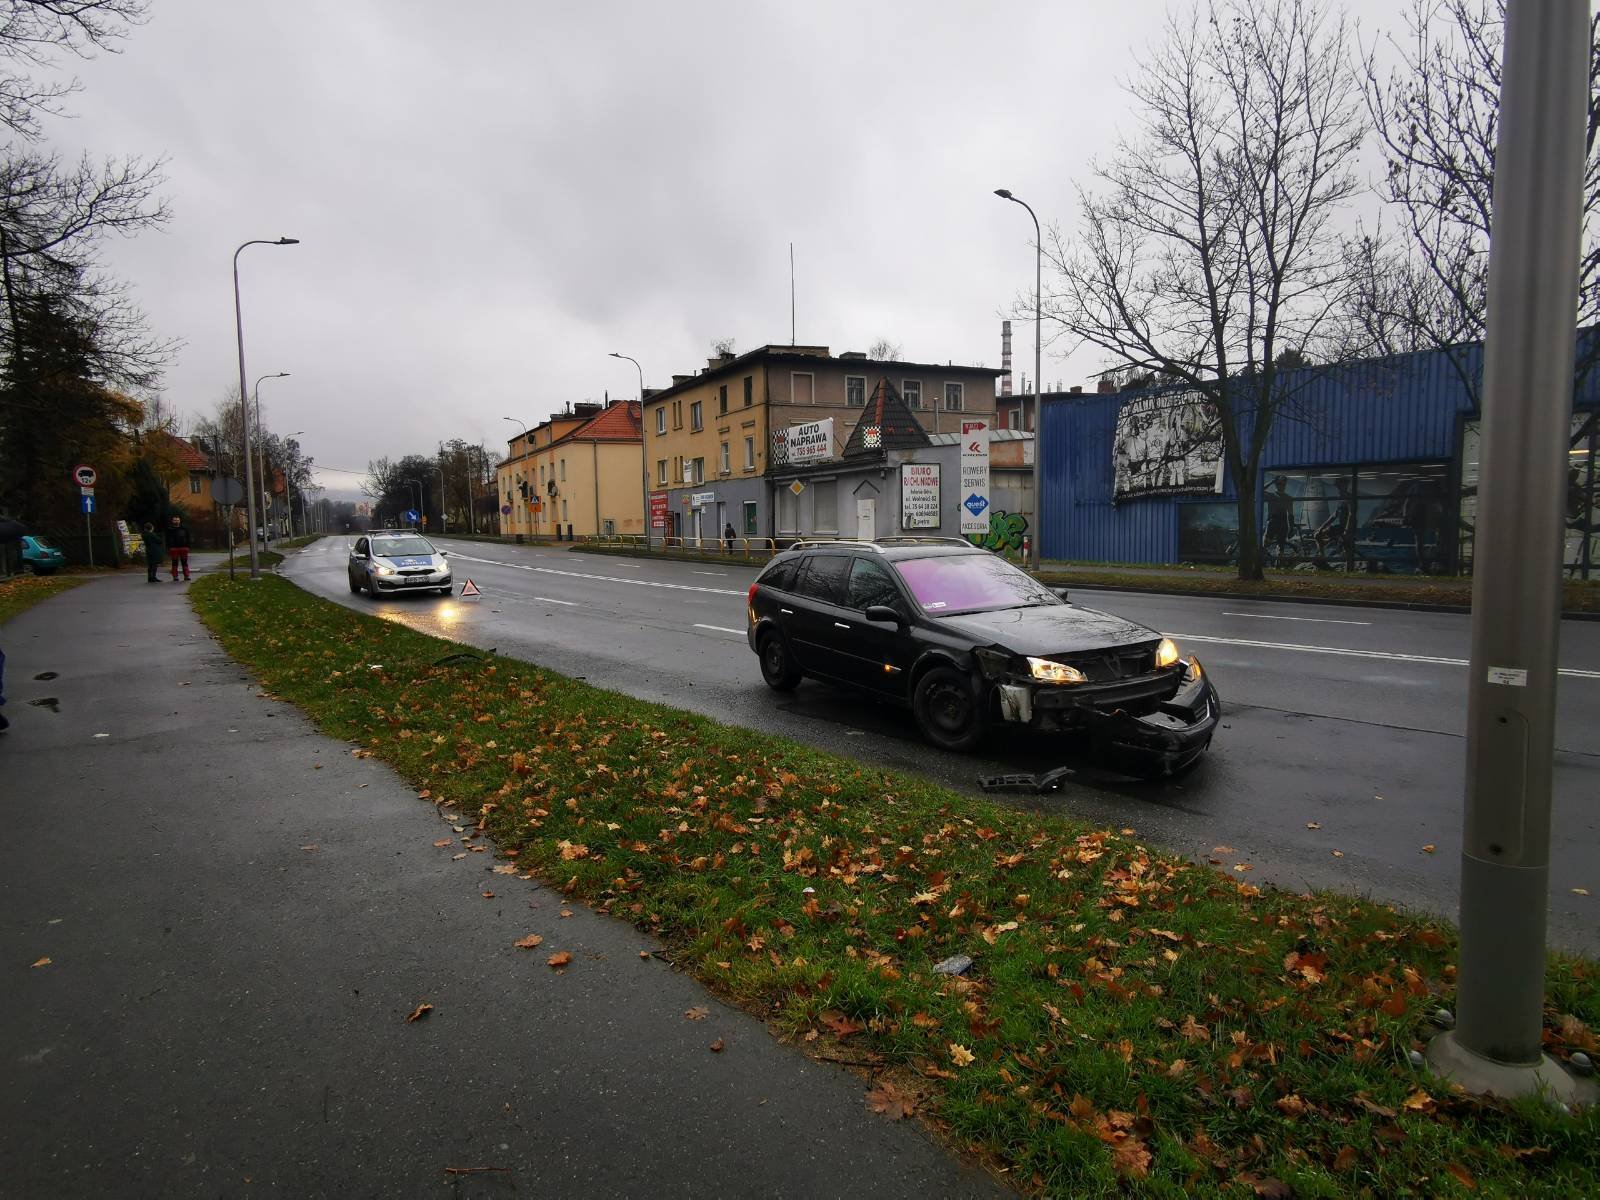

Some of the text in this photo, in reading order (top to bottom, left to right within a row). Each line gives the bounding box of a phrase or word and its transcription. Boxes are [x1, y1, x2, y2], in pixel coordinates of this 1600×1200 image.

[798, 424, 819, 436] AUTO
[790, 433, 827, 447] NAPRAWA
[816, 443, 827, 453] 444
[911, 467, 931, 476] BIURO
[963, 466, 987, 475] ROWERY
[963, 478, 986, 487] SERWIS
[961, 522, 988, 530] AKCESORIA
